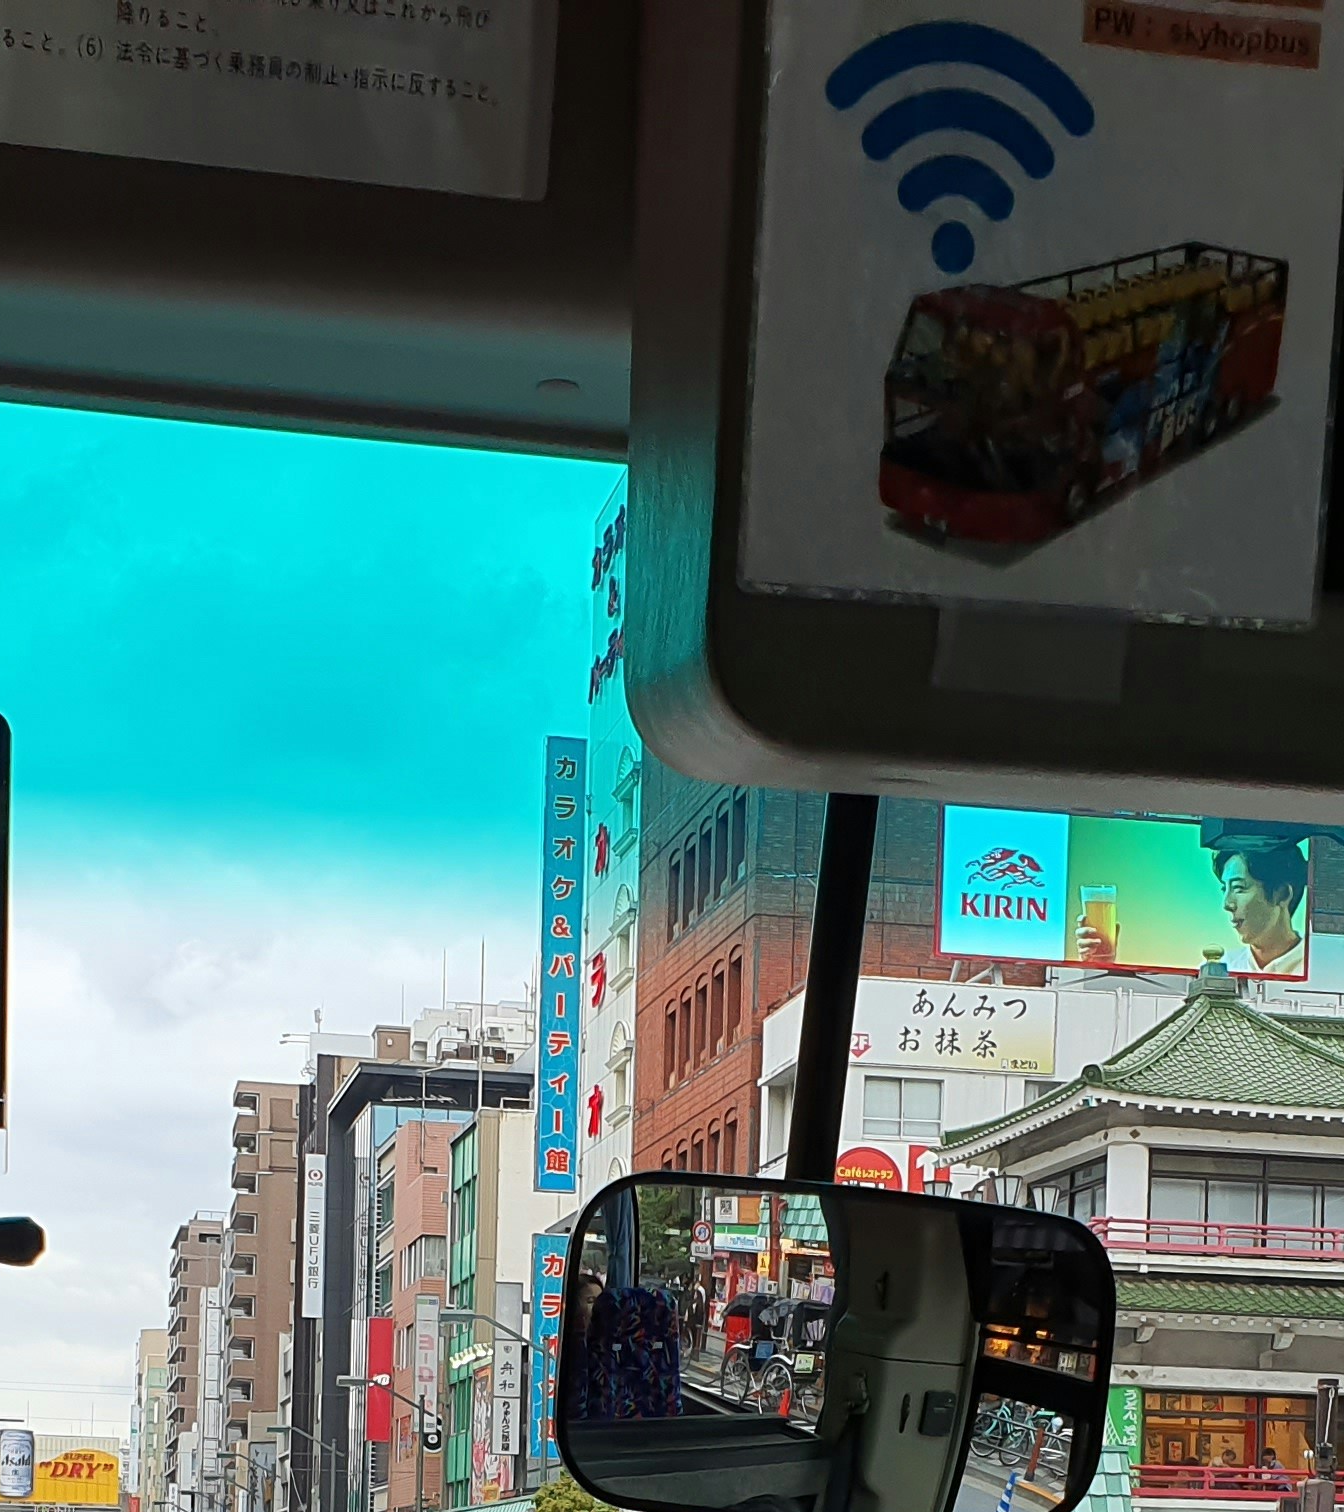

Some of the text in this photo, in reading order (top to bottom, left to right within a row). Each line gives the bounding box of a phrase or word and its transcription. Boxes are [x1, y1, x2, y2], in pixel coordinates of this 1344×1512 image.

[1094, 7, 1136, 38] PW
[1169, 19, 1310, 57] skyhopbus
[960, 891, 1048, 923] KIRIN
[543, 755, 578, 1174] カラオケ&パーティー館
[911, 988, 1030, 1020] あんみつ
[898, 1026, 998, 1058] お抹茶
[1, 1454, 31, 1467] Asahi
